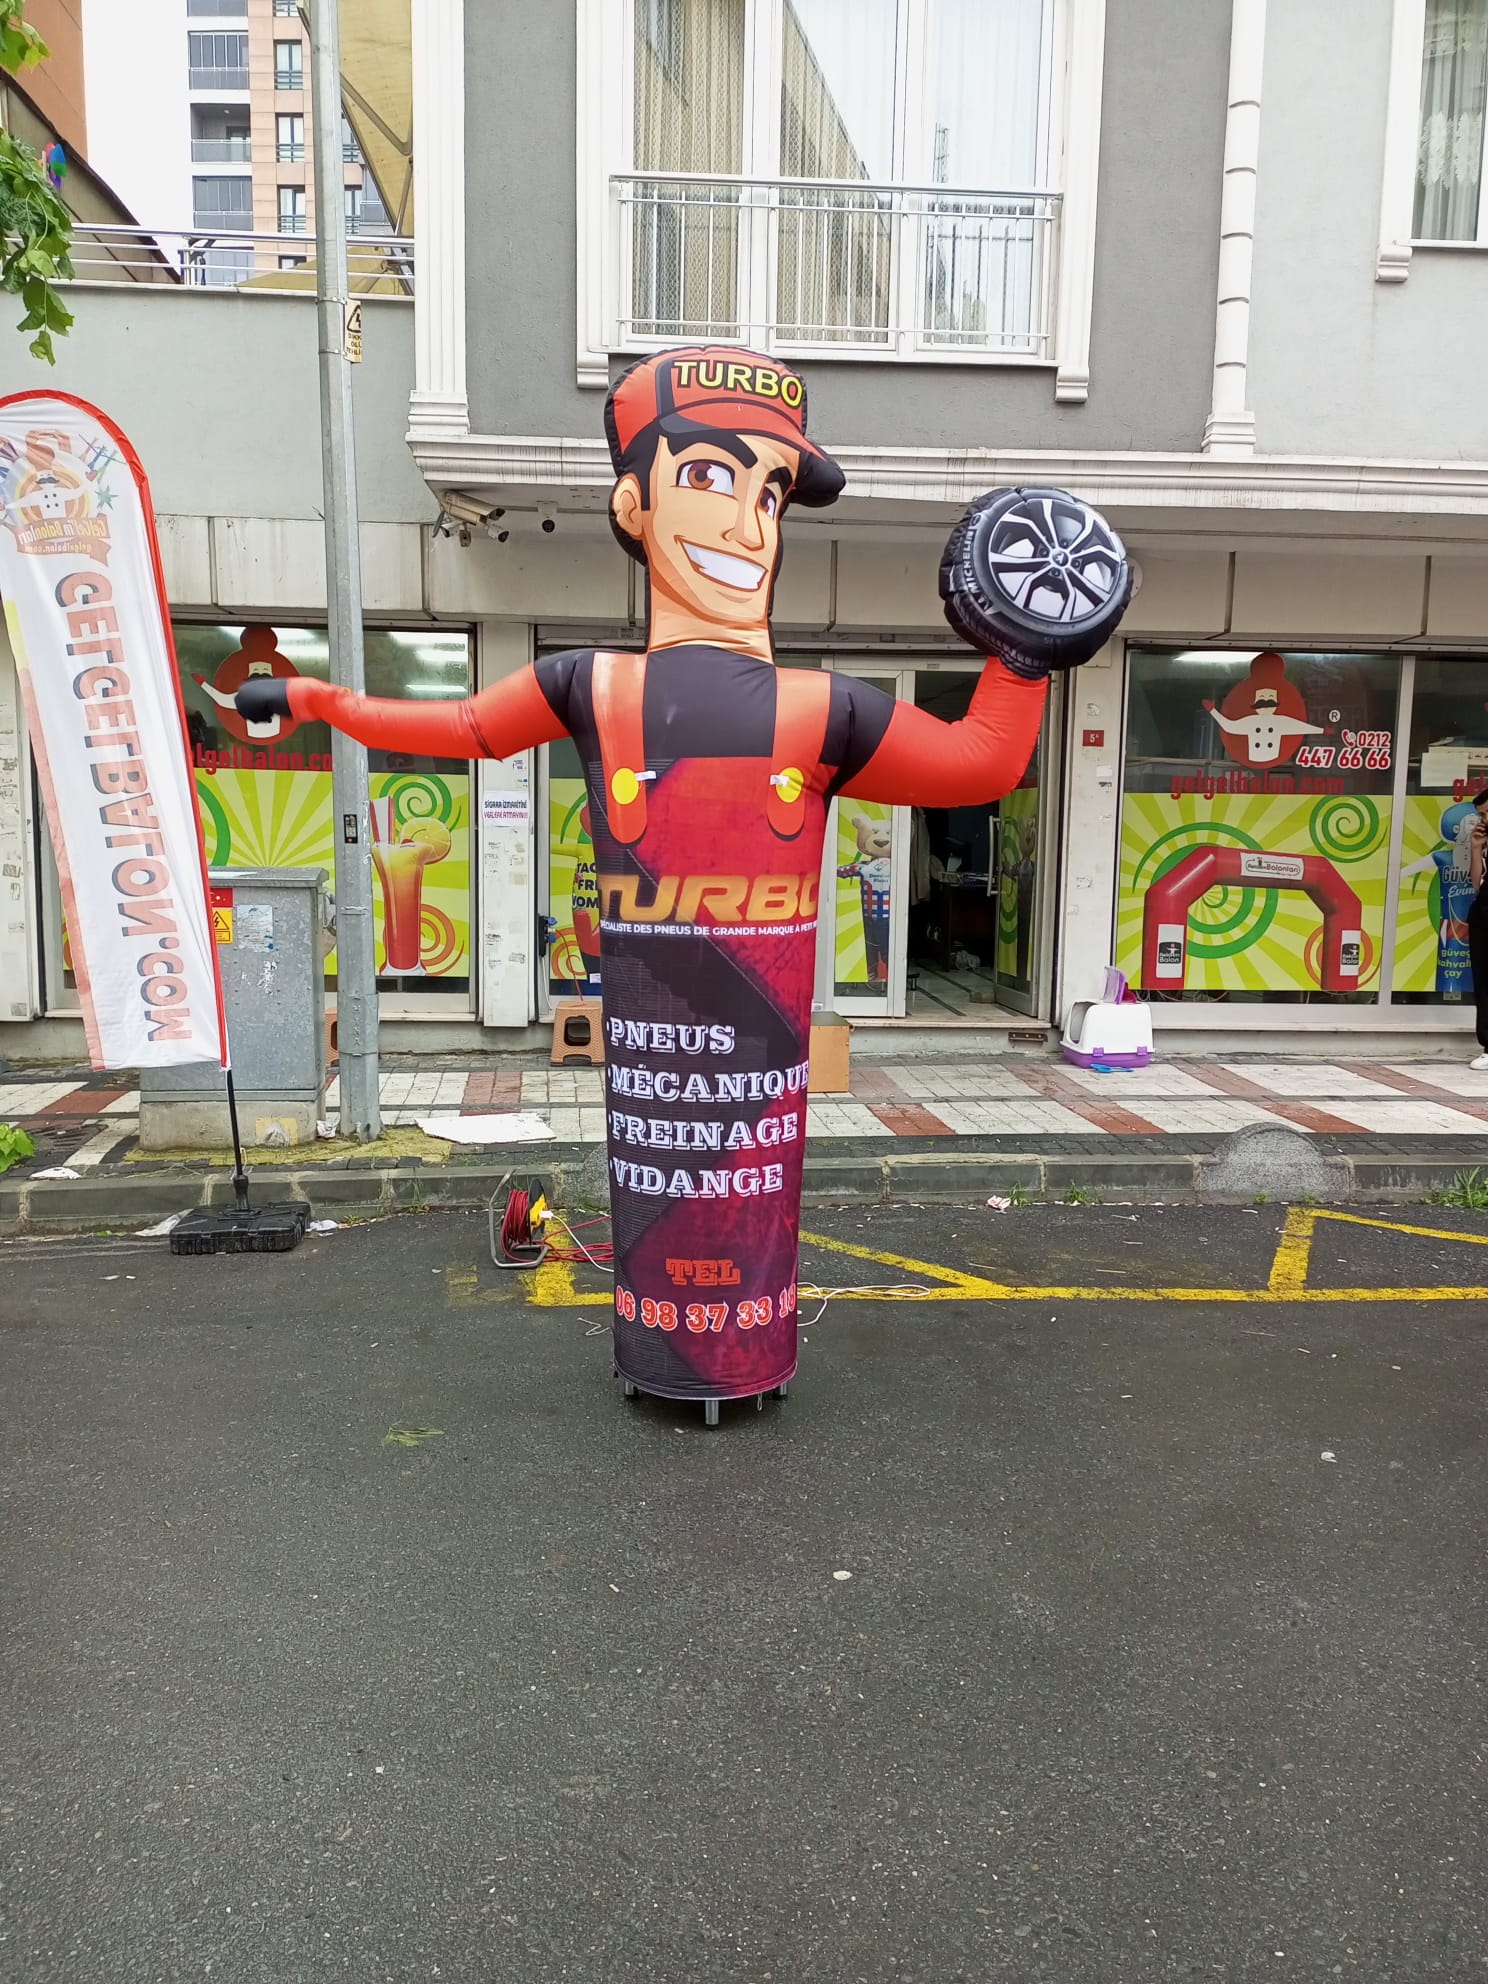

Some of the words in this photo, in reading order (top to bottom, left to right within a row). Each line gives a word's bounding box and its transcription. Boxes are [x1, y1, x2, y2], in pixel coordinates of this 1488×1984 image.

[673, 360, 805, 408] TURBO
[962, 530, 979, 595] MICHELIN
[1357, 731, 1391, 748] 0212
[193, 742, 332, 775] lgelbalon.co
[1296, 747, 1335, 767] 447
[1338, 747, 1362, 768] 66
[1366, 748, 1391, 769] 66
[1170, 769, 1345, 800] gelgelbalon.com
[633, 924, 652, 934] DES
[654, 925, 691, 935] PNEUS
[693, 926, 710, 936] DE
[712, 926, 757, 936] GRANDE
[758, 925, 794, 936] MARQUE
[609, 1016, 735, 1054] PNEUS
[611, 1110, 798, 1151] FREINAGE
[612, 1156, 783, 1199] VIDANGE
[666, 1258, 741, 1286] TEL
[616, 1285, 636, 1321] 06
[641, 1297, 678, 1331] 98
[686, 1301, 729, 1333] 37
[737, 1296, 773, 1330] 33
